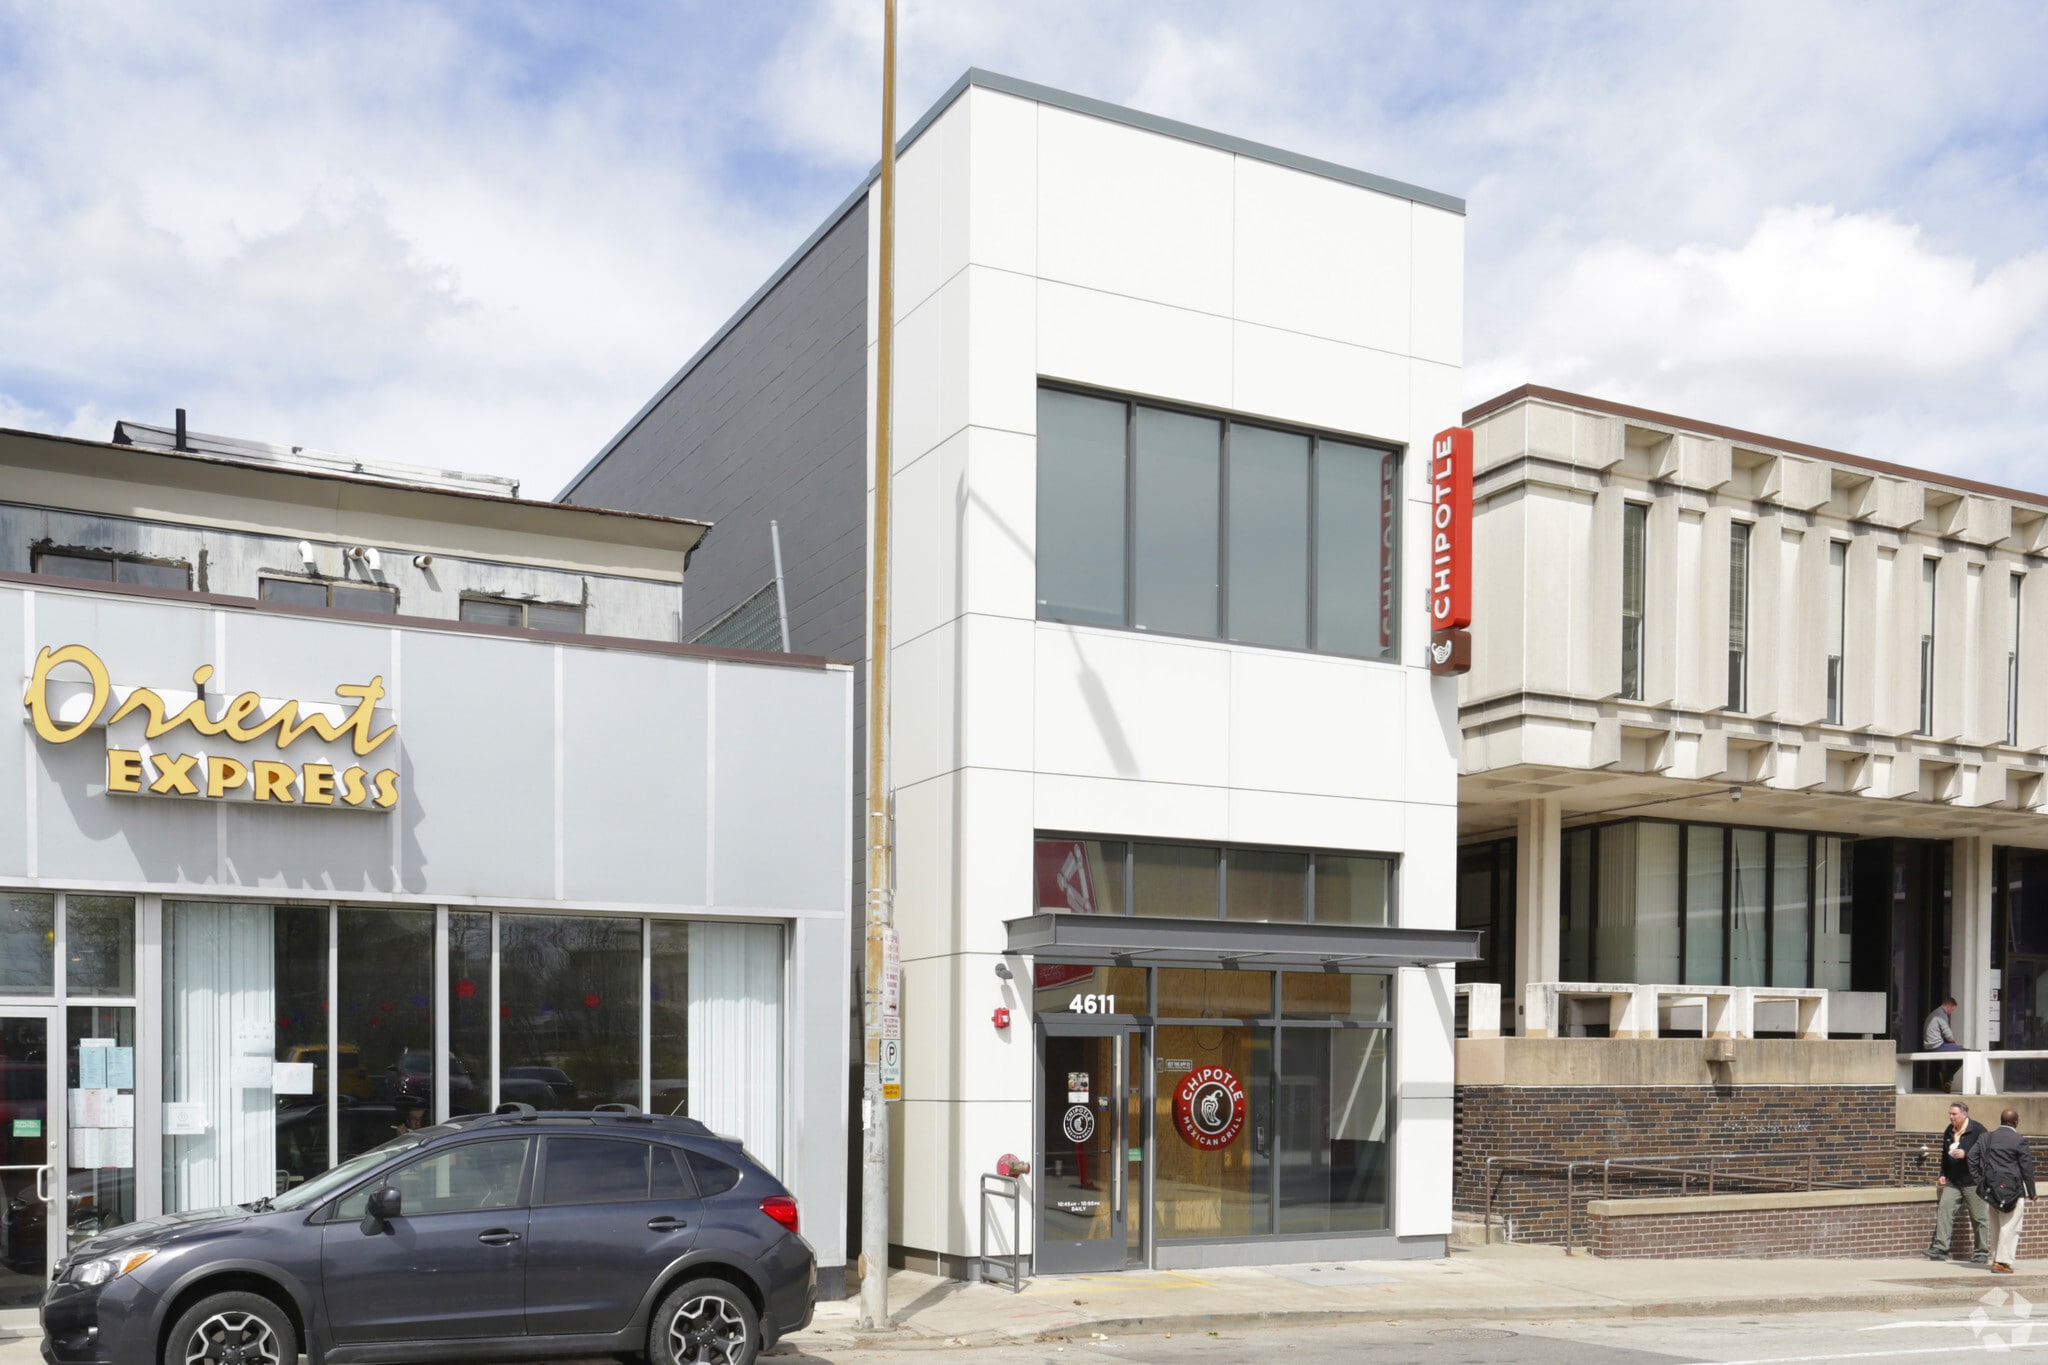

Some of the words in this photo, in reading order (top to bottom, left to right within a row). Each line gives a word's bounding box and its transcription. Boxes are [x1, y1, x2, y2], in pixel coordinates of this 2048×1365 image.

[1433, 435, 1453, 620] CHIPOTLE
[24, 644, 398, 756] Orient
[107, 748, 401, 808] EXPRESS
[1069, 993, 1115, 1014] 4611
[888, 1046, 895, 1062] P
[1182, 1069, 1244, 1102] CHIPOTLE
[1066, 1107, 1092, 1121] CHIPOTLE
[1183, 1116, 1219, 1146] MEXICAN
[1220, 1116, 1242, 1143] GRILL
